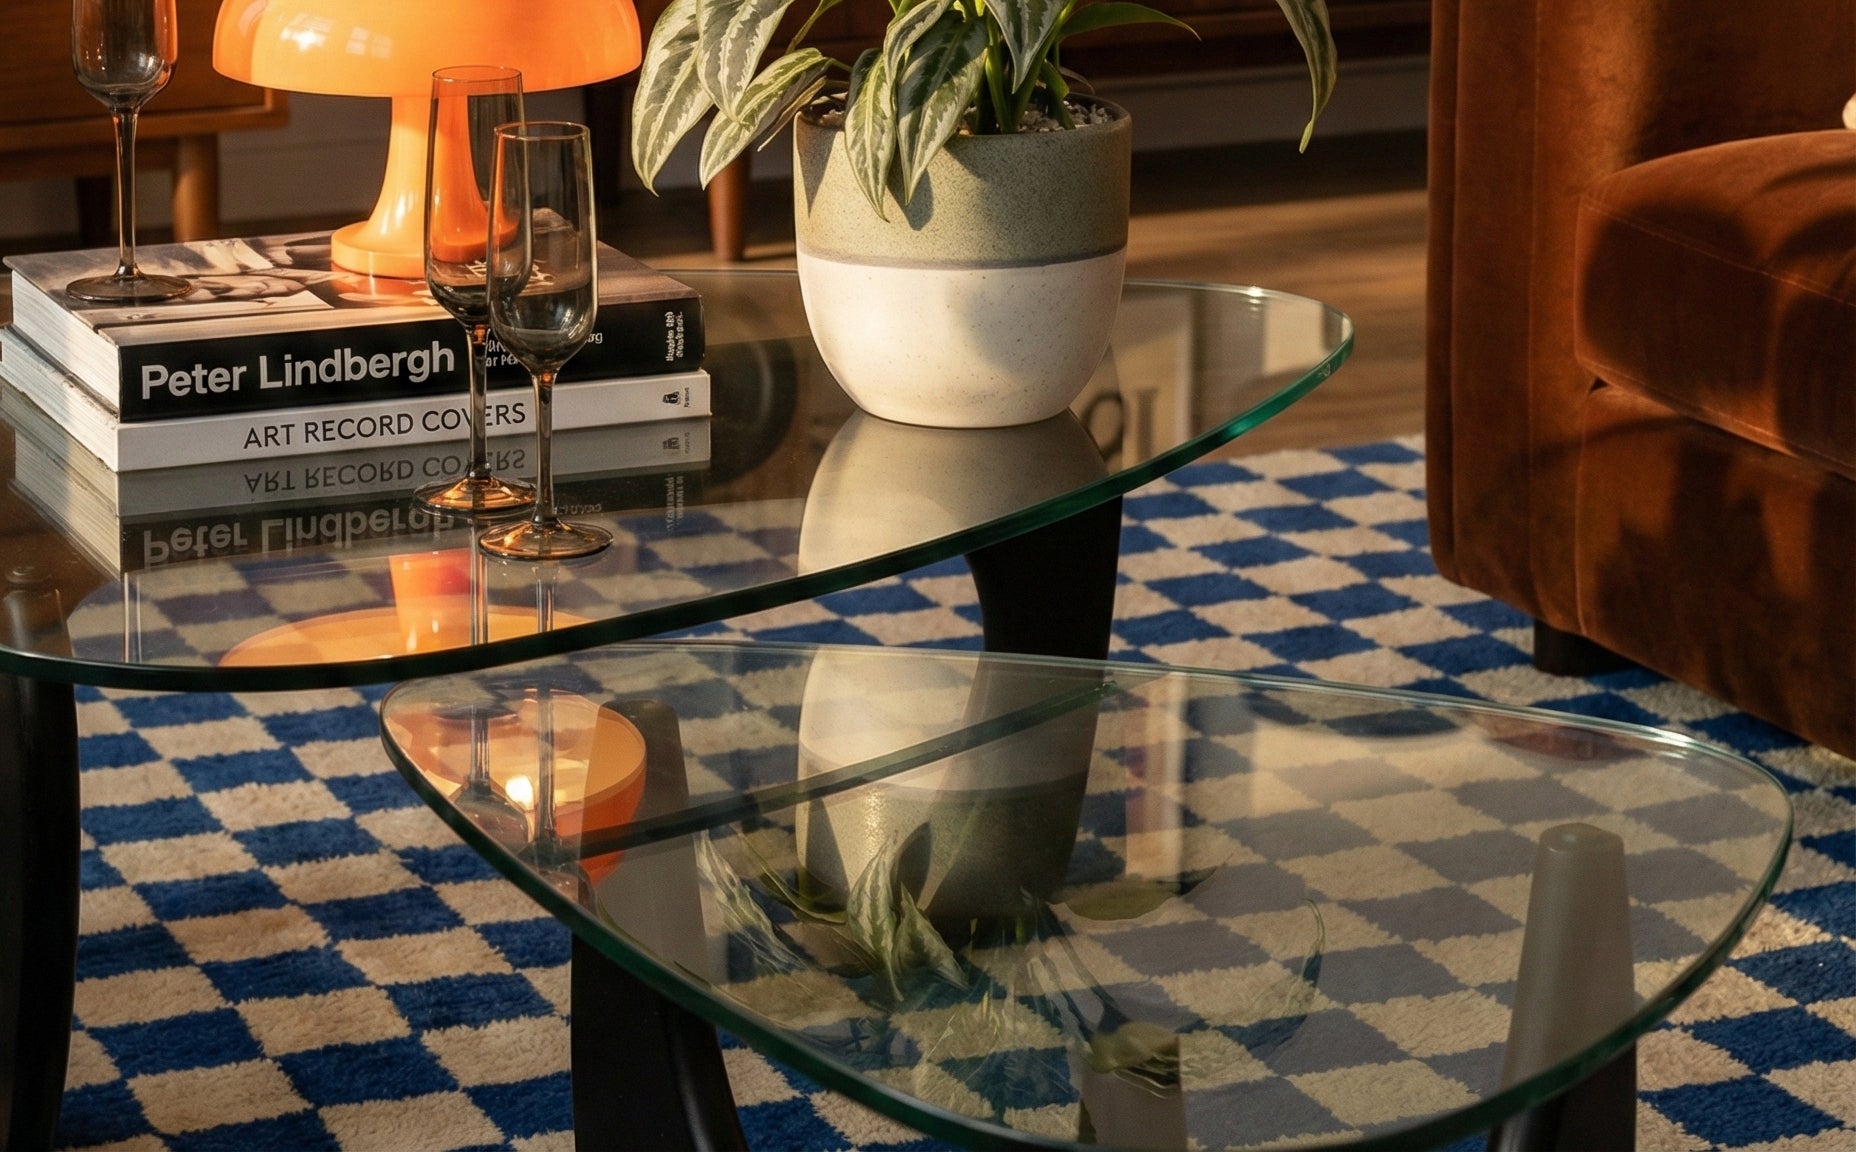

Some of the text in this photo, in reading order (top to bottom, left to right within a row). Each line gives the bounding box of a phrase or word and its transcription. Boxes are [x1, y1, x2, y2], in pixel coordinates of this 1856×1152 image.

[141, 340, 455, 399] Peter Lindbergh
[243, 424, 296, 449] ART
[304, 413, 414, 443] RECORD
